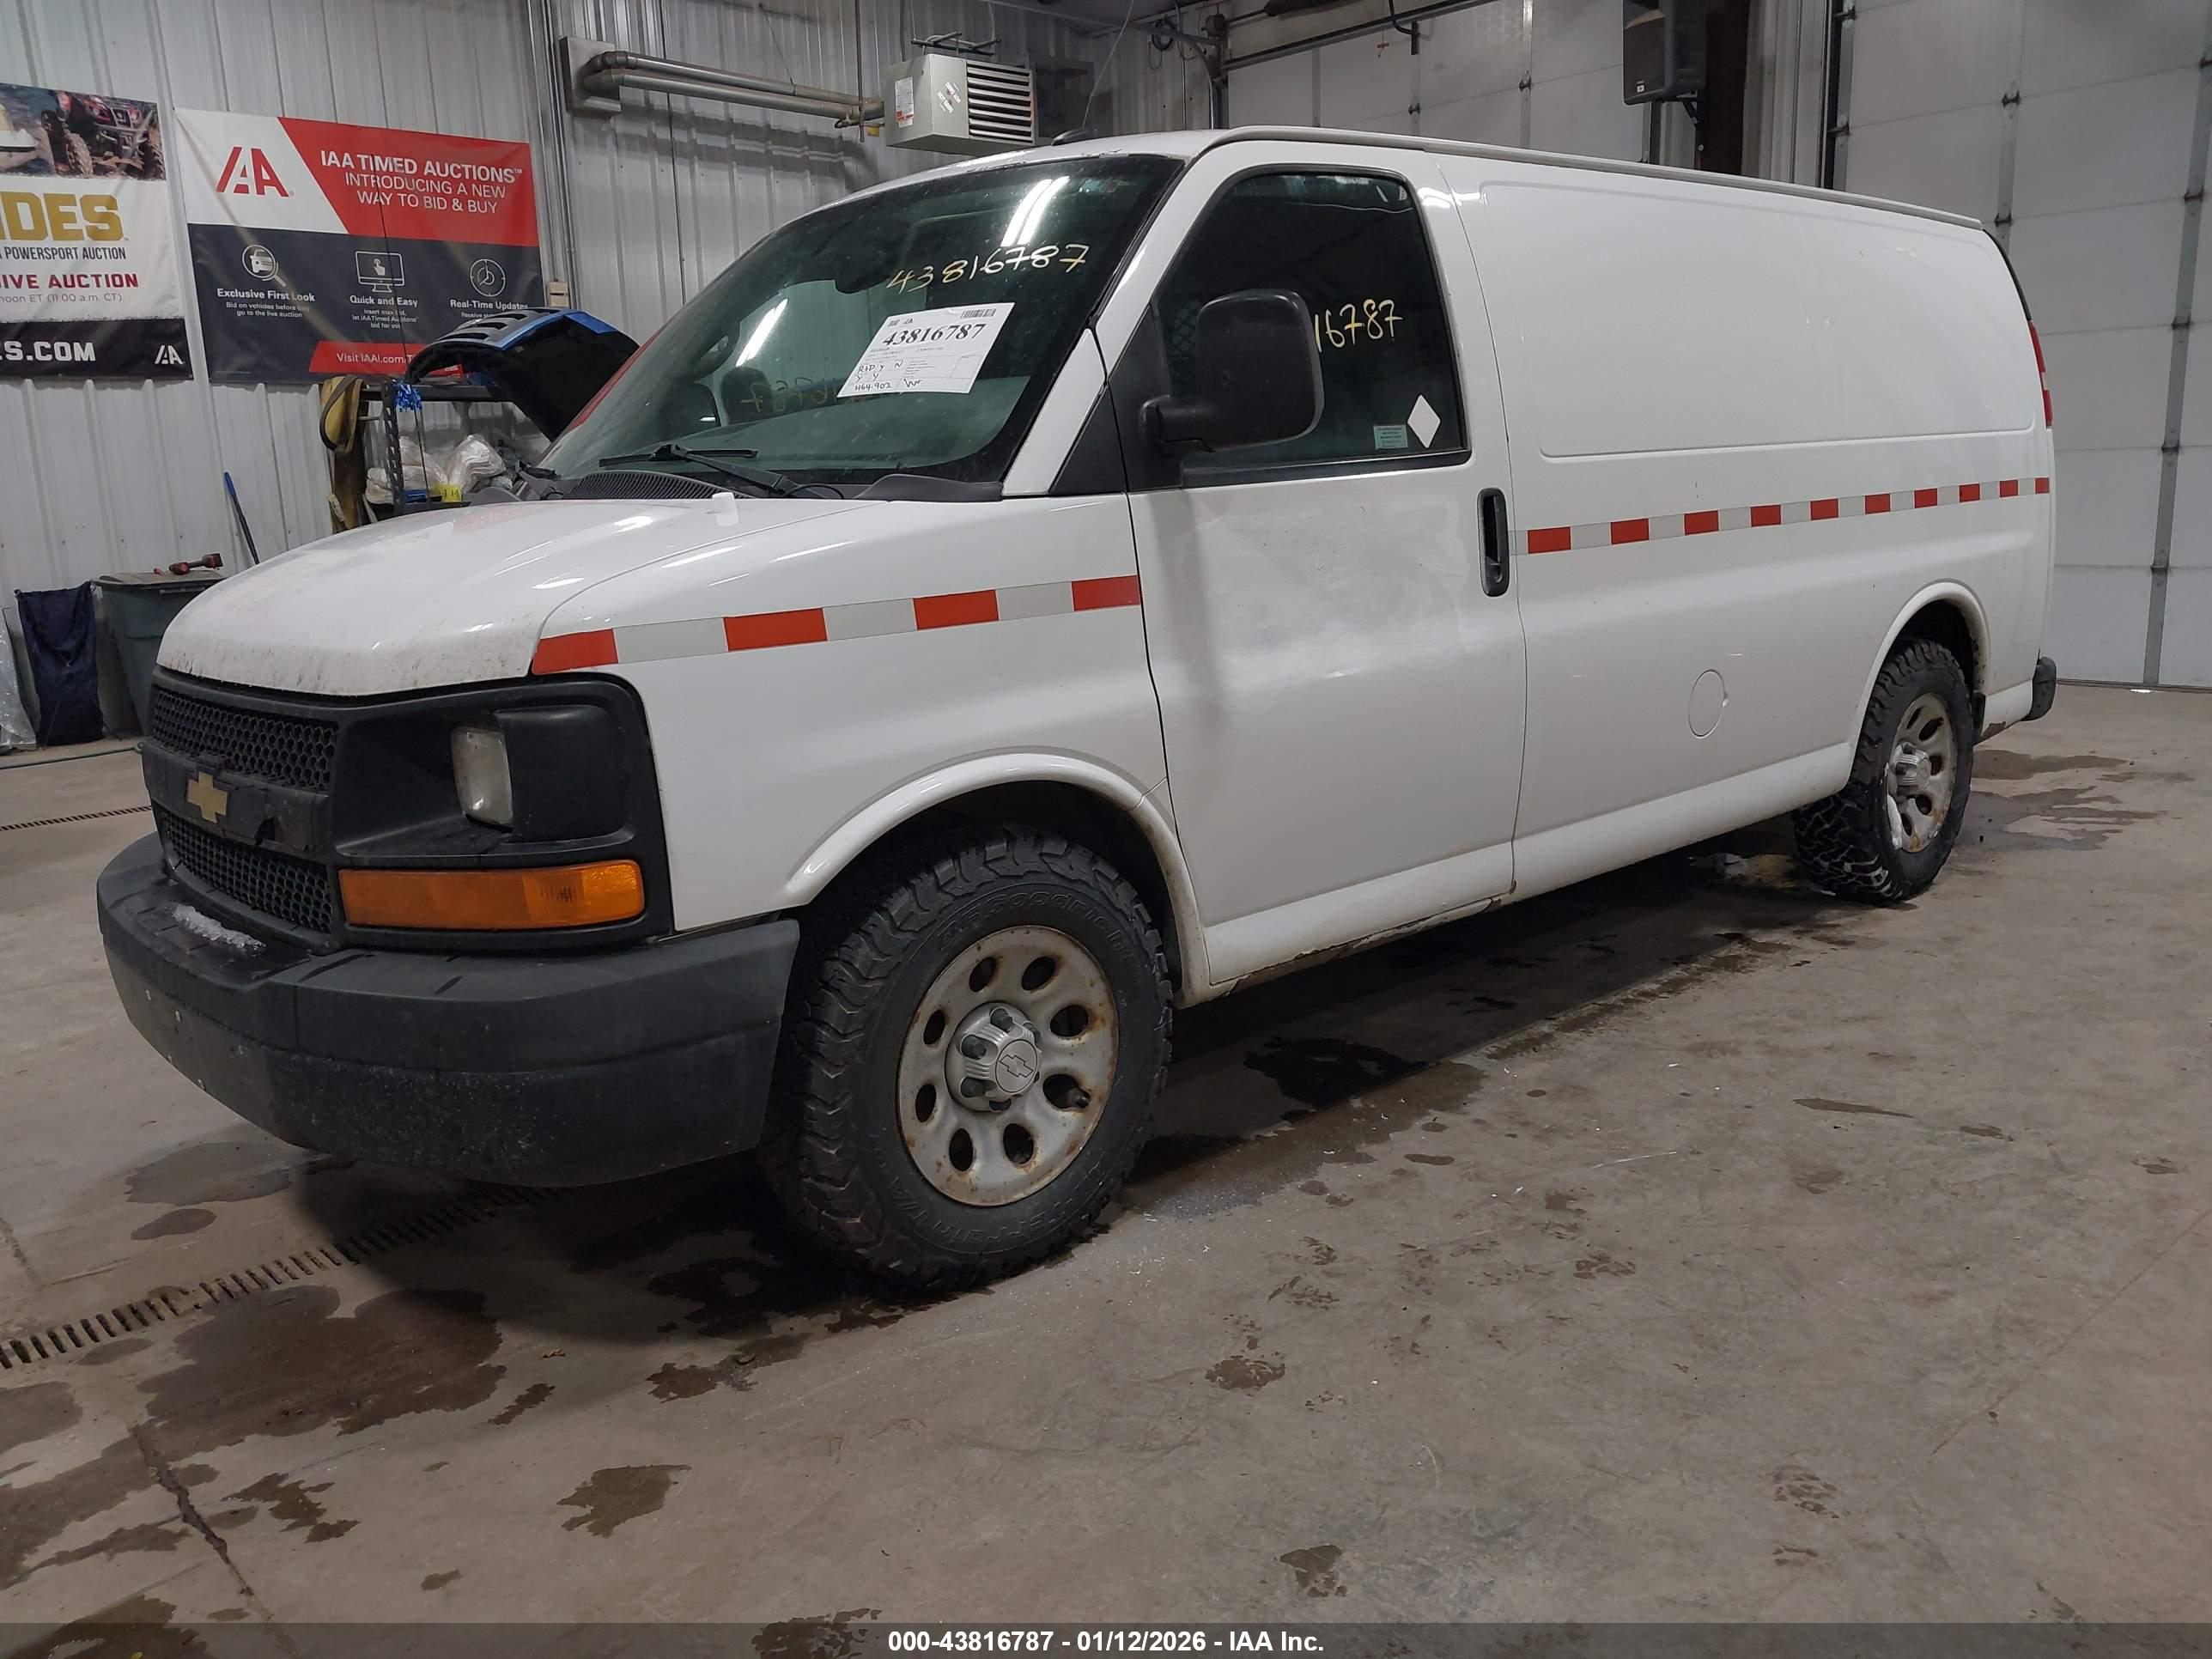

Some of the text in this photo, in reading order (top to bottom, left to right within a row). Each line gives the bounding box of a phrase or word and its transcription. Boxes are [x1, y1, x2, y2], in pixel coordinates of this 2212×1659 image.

[320, 149, 355, 169] IAA
[356, 154, 418, 175] TIMED
[345, 172, 506, 199] INTRODUCING A NEW
[357, 190, 498, 215] WAY TO BID & BUY
[0, 191, 125, 241] DES
[4, 246, 79, 260] POWERSPORT
[82, 246, 127, 260] AUCTION
[886, 244, 1091, 295] 43816787
[0, 273, 139, 289] IVE AUCTION
[28, 294, 43, 302] ET
[216, 288, 316, 302] Exclusive First Look
[349, 295, 418, 308] Quick and Easy
[450, 300, 529, 311] Real-Time Updates
[882, 323, 988, 346] 43816787
[1314, 298, 1404, 353] 16787
[0, 340, 96, 362] S.COM
[337, 354, 414, 365] Visit IAAI.com/T
